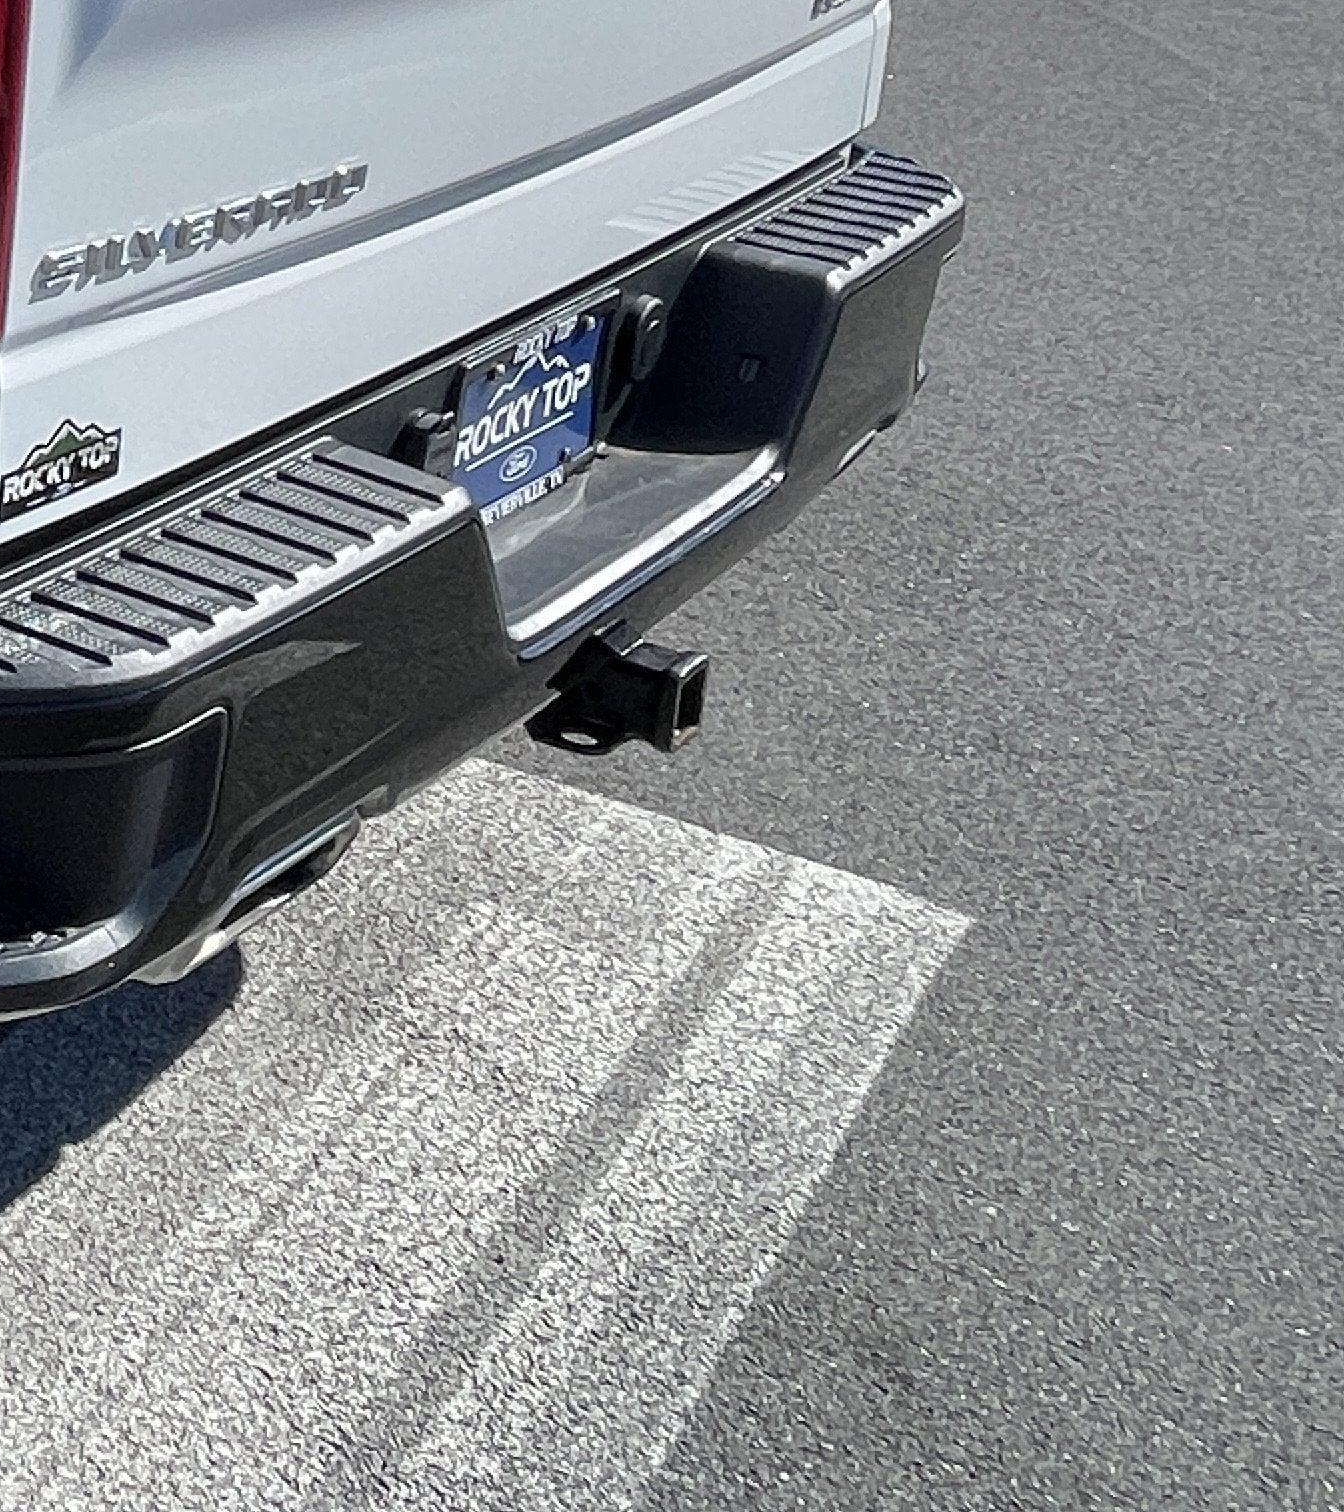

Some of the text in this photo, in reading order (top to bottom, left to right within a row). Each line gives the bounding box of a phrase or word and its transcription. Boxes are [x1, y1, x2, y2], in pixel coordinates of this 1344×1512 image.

[27, 162, 370, 306] SILVERADO
[453, 363, 592, 467] ROCKY TOP
[2, 436, 118, 504] ROCKY TOP
